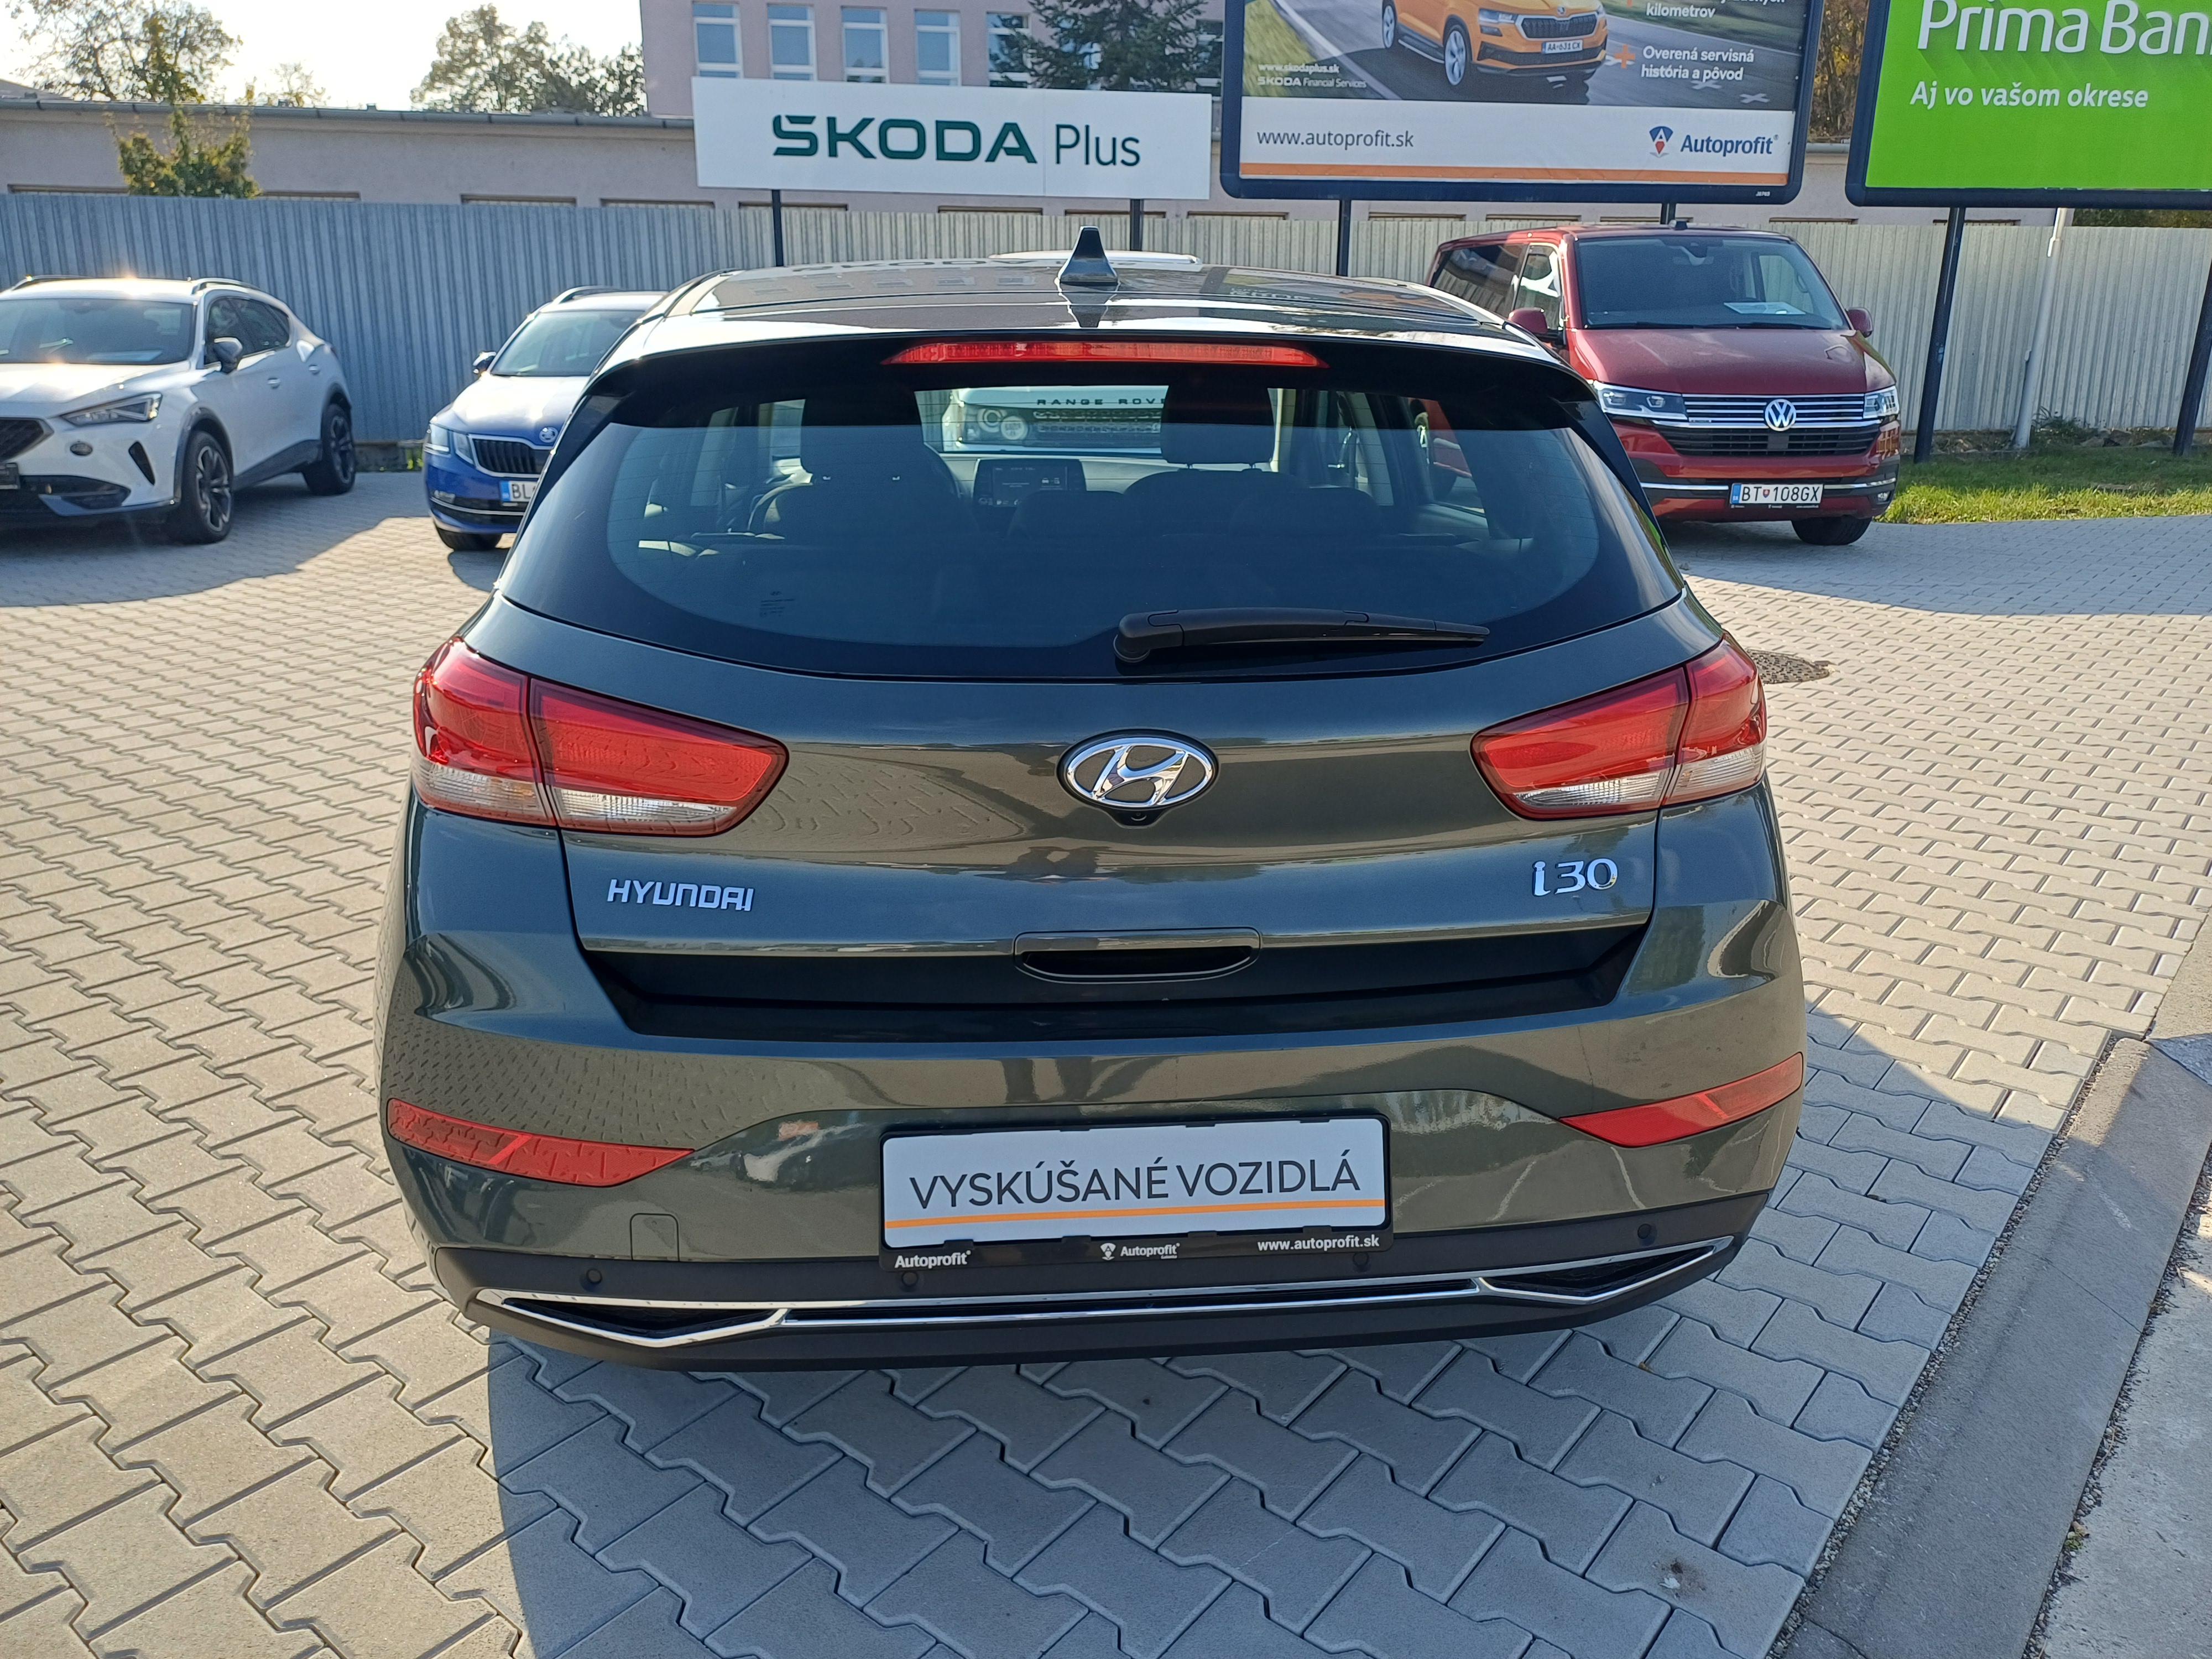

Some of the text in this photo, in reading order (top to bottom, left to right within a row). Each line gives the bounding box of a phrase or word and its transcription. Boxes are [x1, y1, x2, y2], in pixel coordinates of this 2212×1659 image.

[1646, 4, 1715, 18] kilometrov
[1917, 0, 2211, 55] Prima Ban
[1642, 45, 1754, 62] Overená servisná
[1303, 77, 1334, 87] Financial
[1335, 79, 1367, 88] Services
[1641, 64, 1744, 82] história a pôvod
[1910, 81, 2148, 109] Aj vo vašom okrese
[1056, 124, 1141, 166] Plus
[1257, 129, 1413, 150] www.autoprofit.sk
[1680, 134, 1773, 156] Autoprofit
[1533, 858, 1618, 896] i30
[607, 879, 754, 911] HYUNDAI
[908, 1149, 1361, 1210] VYSKÚŠANÉ VOZIDLÁ
[894, 1234, 1380, 1269] Autoprofit Autoprofit www.autoprofit.sk
